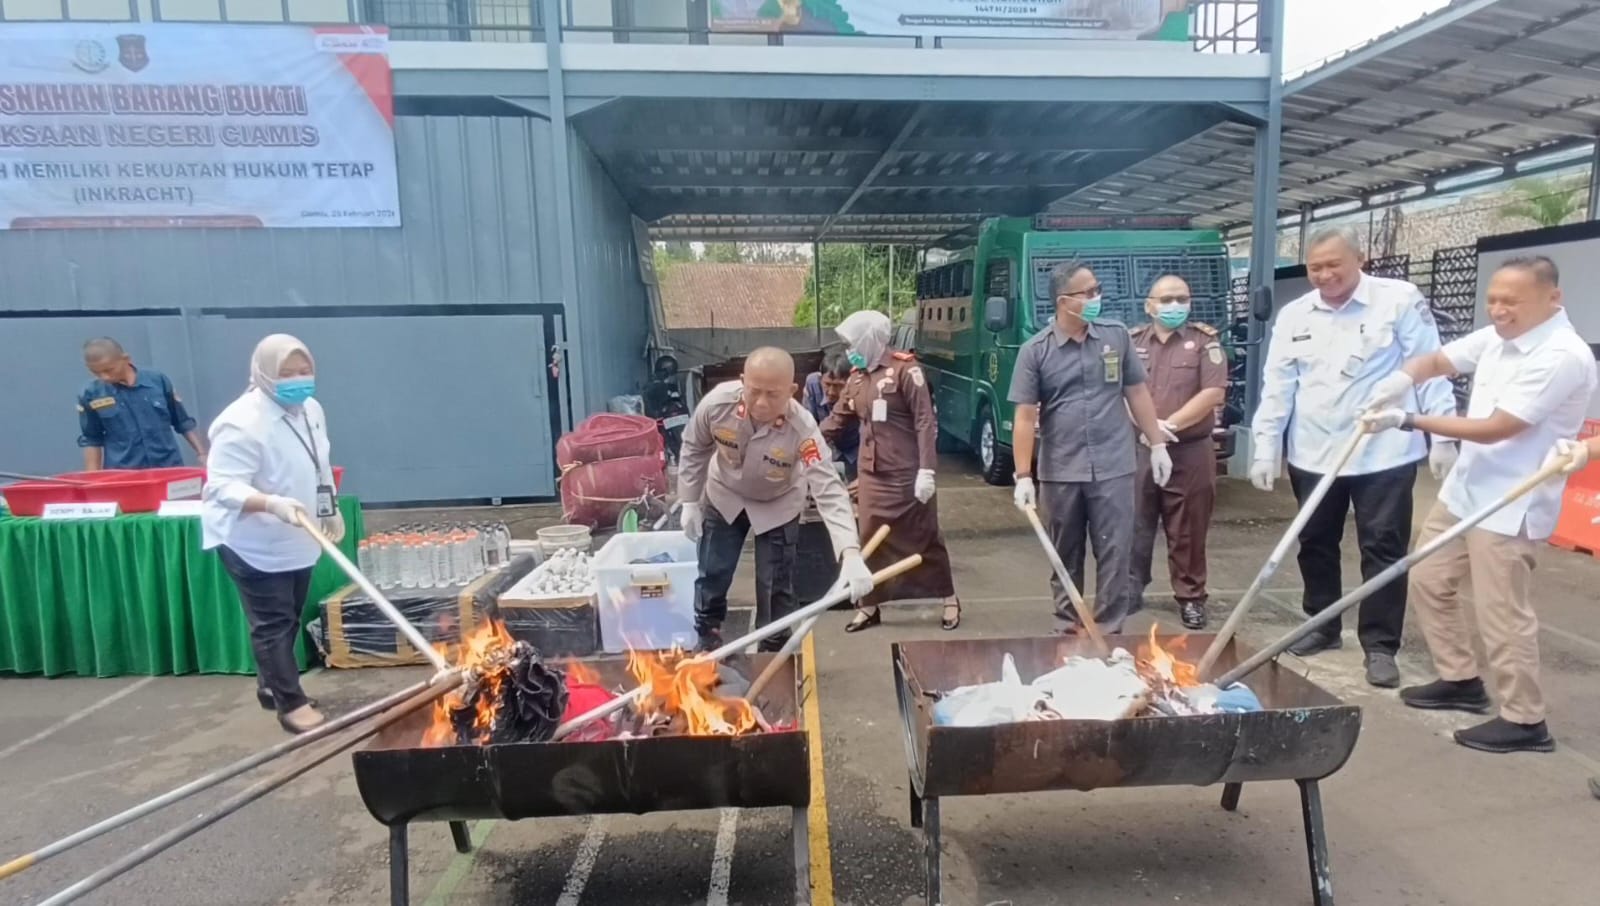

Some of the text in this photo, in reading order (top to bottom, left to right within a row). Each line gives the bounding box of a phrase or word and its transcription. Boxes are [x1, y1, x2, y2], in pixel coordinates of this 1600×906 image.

[0, 84, 308, 115] SNAHAN BARANG BUKTI
[0, 124, 319, 147] KSAAN NEGERI CIAMIS
[14, 163, 111, 178] MEMILIKI
[118, 162, 226, 178] KEKUATAN
[233, 162, 308, 178] HUKUM
[313, 162, 375, 178] TETAP
[74, 186, 194, 206] (INKRACHT)
